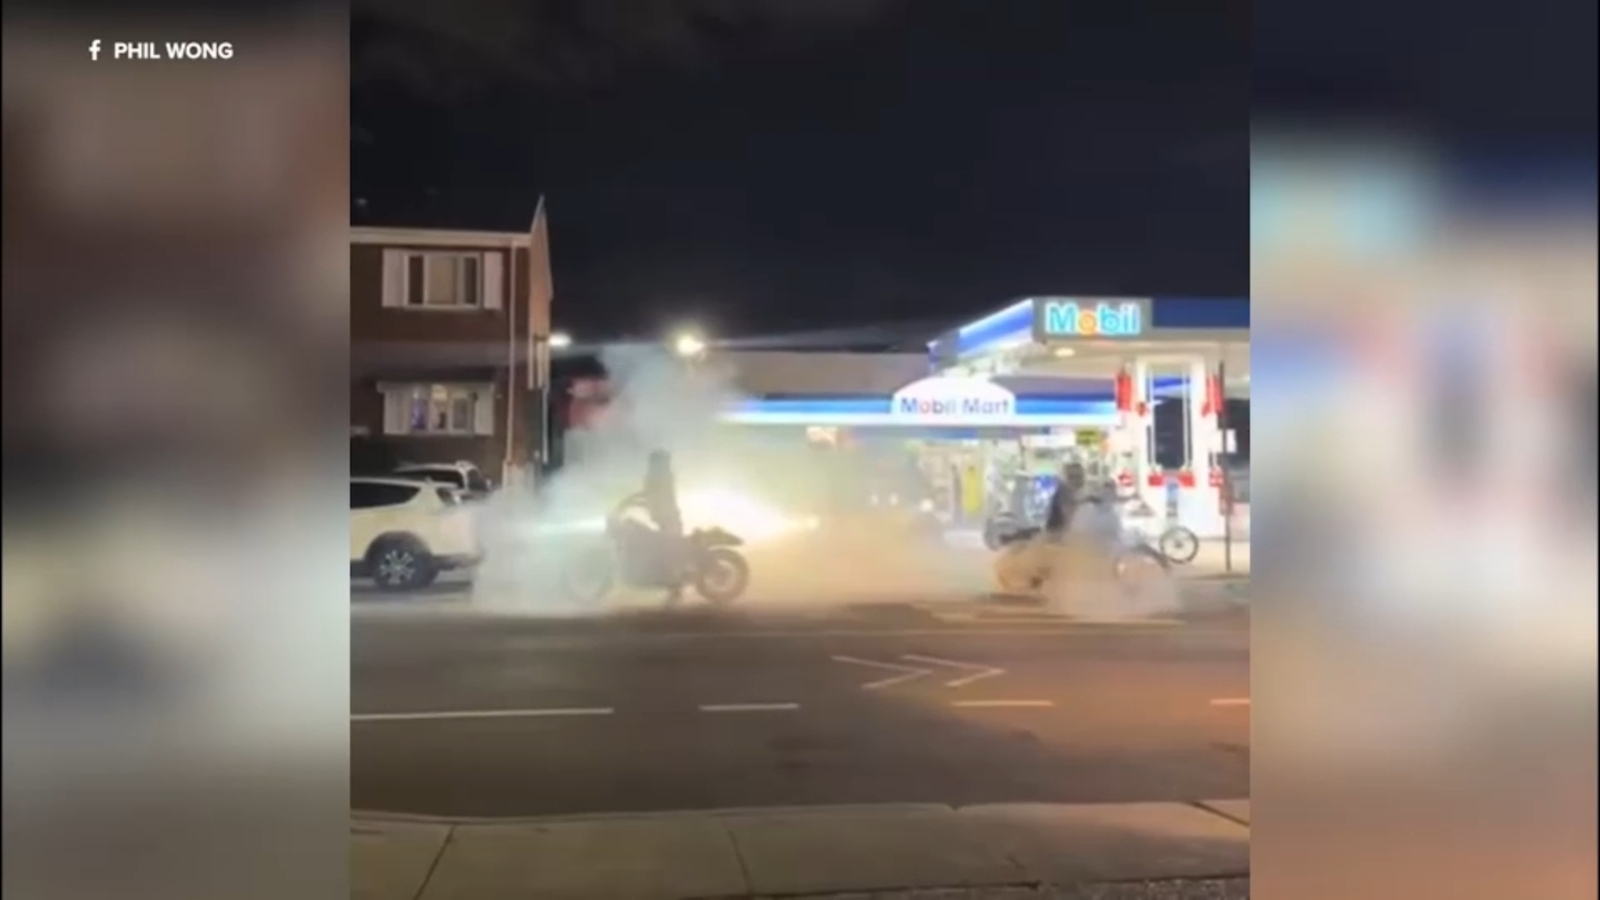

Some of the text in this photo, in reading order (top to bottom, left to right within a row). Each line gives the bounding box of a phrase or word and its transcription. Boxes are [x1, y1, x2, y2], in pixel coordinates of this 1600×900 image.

[1045, 301, 1141, 336] Mobil
[900, 397, 1009, 414] Mobil Mart
